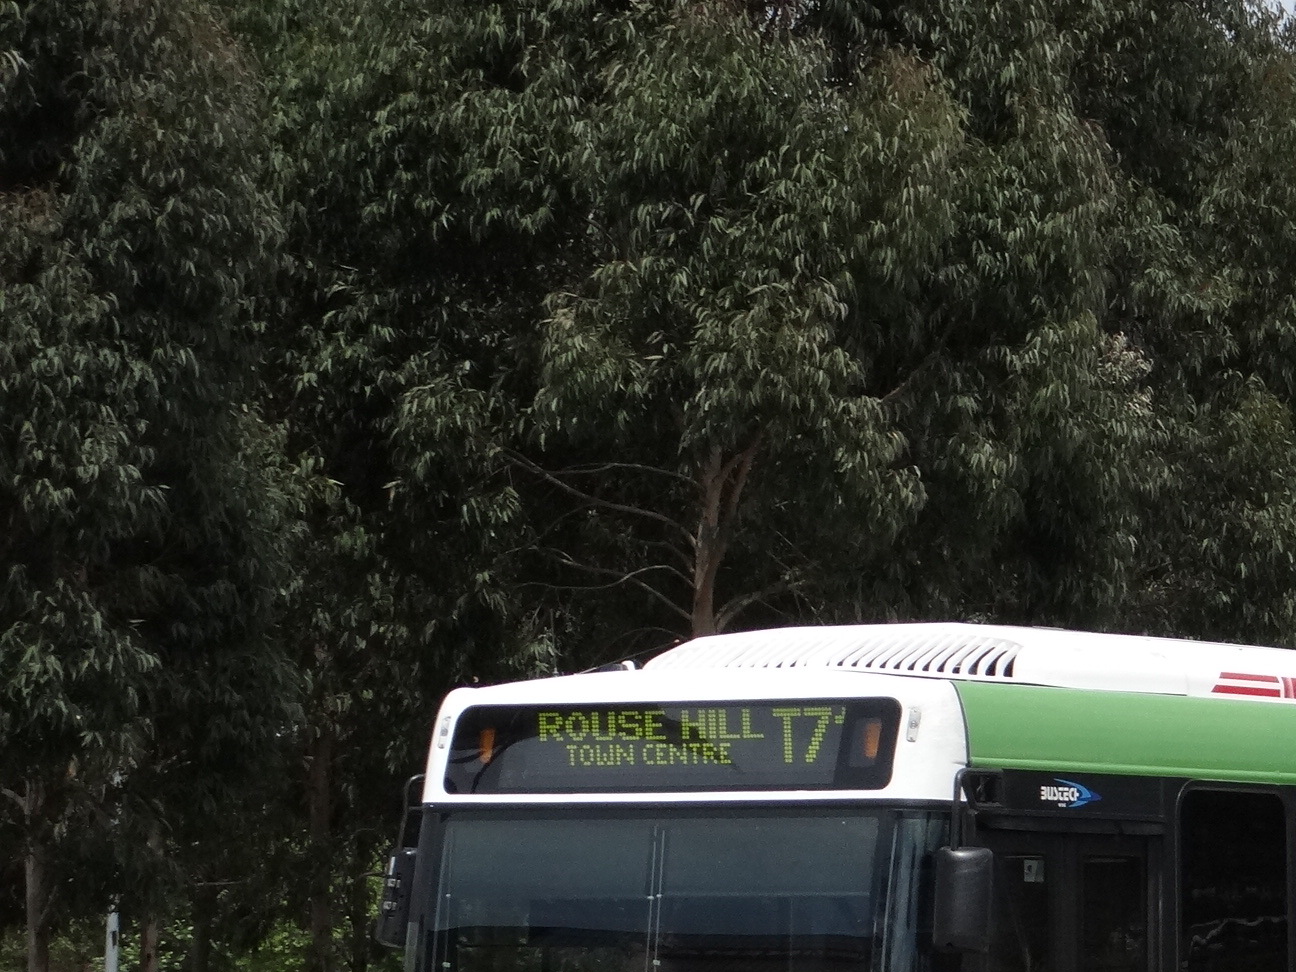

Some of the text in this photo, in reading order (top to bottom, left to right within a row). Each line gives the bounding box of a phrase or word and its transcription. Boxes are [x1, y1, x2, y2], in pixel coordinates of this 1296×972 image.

[538, 706, 847, 763] ROUSE HILL T7
[566, 742, 732, 766] TOWN CENTRE
